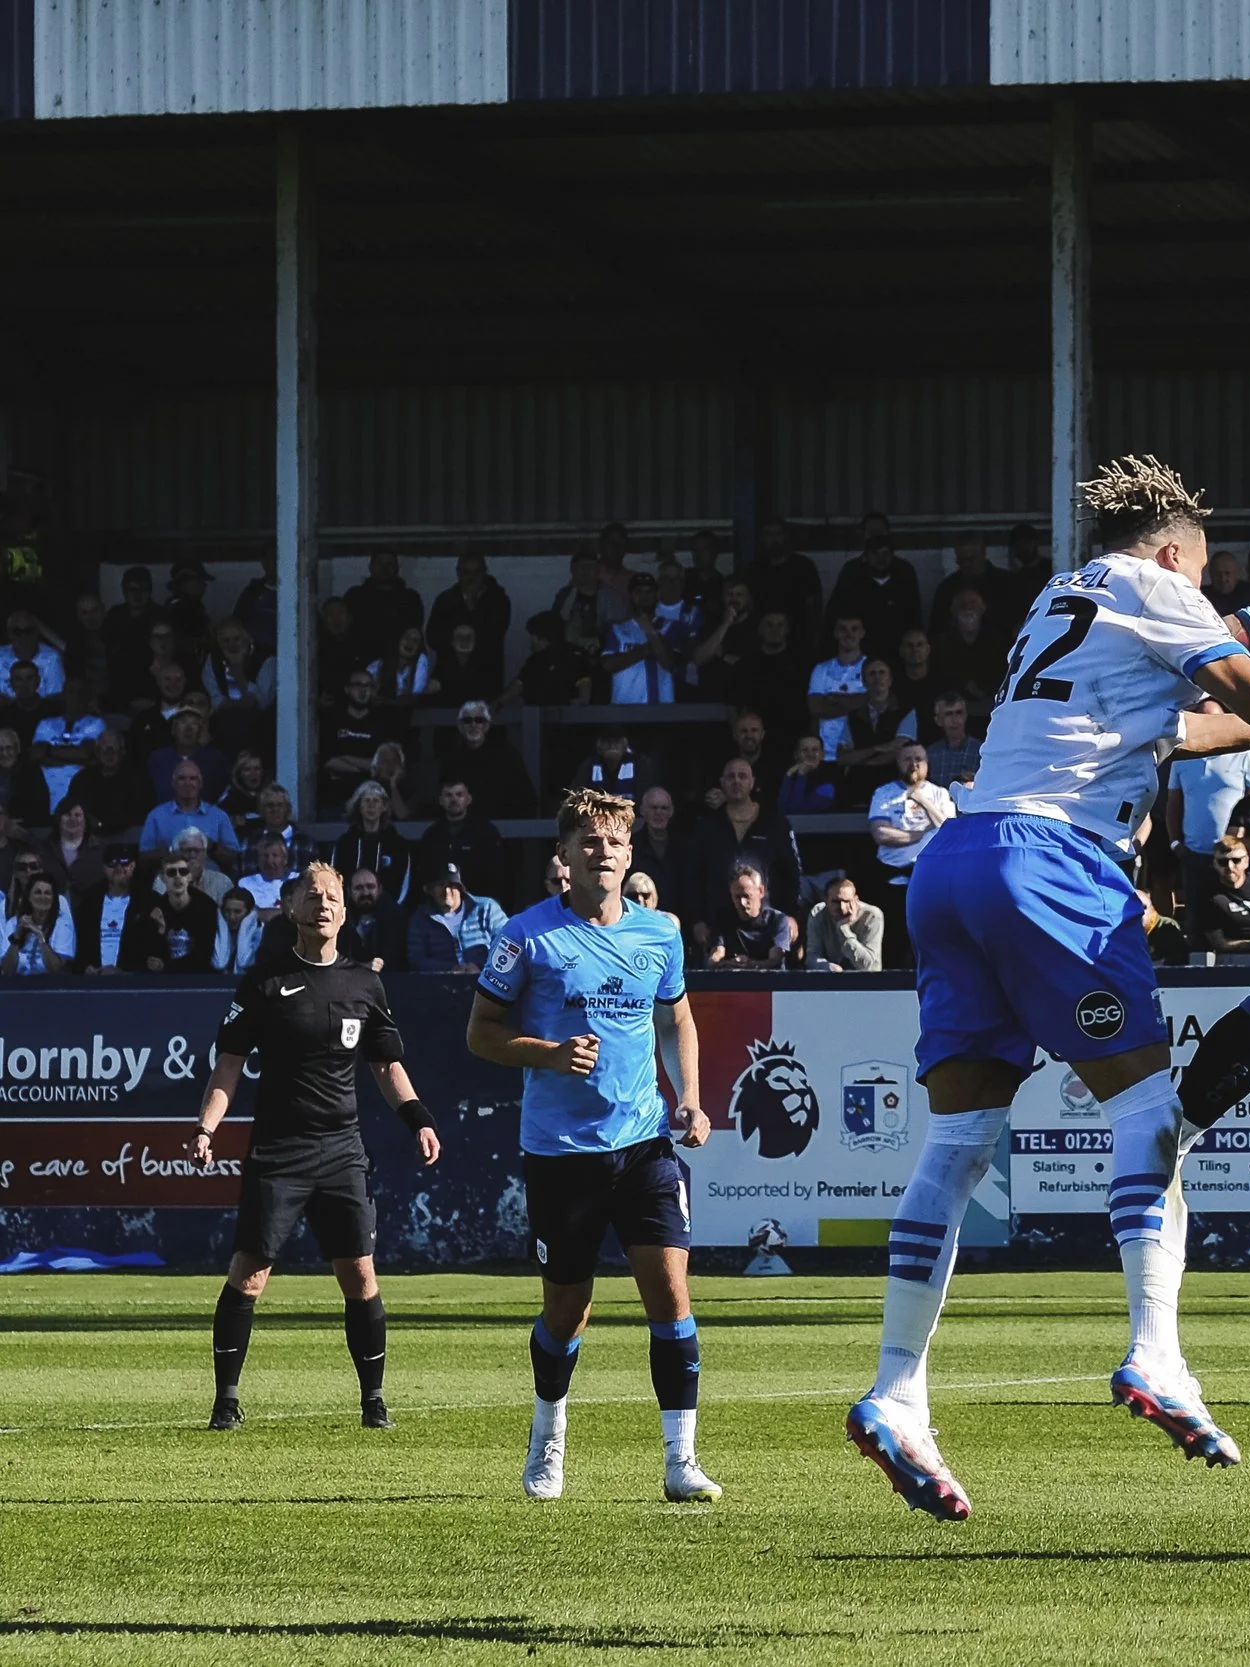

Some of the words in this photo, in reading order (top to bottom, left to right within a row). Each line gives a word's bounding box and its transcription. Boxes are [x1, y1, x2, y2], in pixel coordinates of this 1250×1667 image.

[565, 997, 646, 1009] MORNFLAKE
[1080, 1005, 1121, 1026] DSG
[163, 1035, 196, 1079] &
[1016, 1133, 1057, 1149] TEL:
[101, 1142, 134, 1184] of
[1033, 1160, 1076, 1174] Slating
[1198, 1159, 1231, 1174] Tiling
[708, 1180, 790, 1200] Supported
[794, 1181, 813, 1200] by
[817, 1181, 877, 1198] Premier
[1182, 1180, 1250, 1193] Extensions
